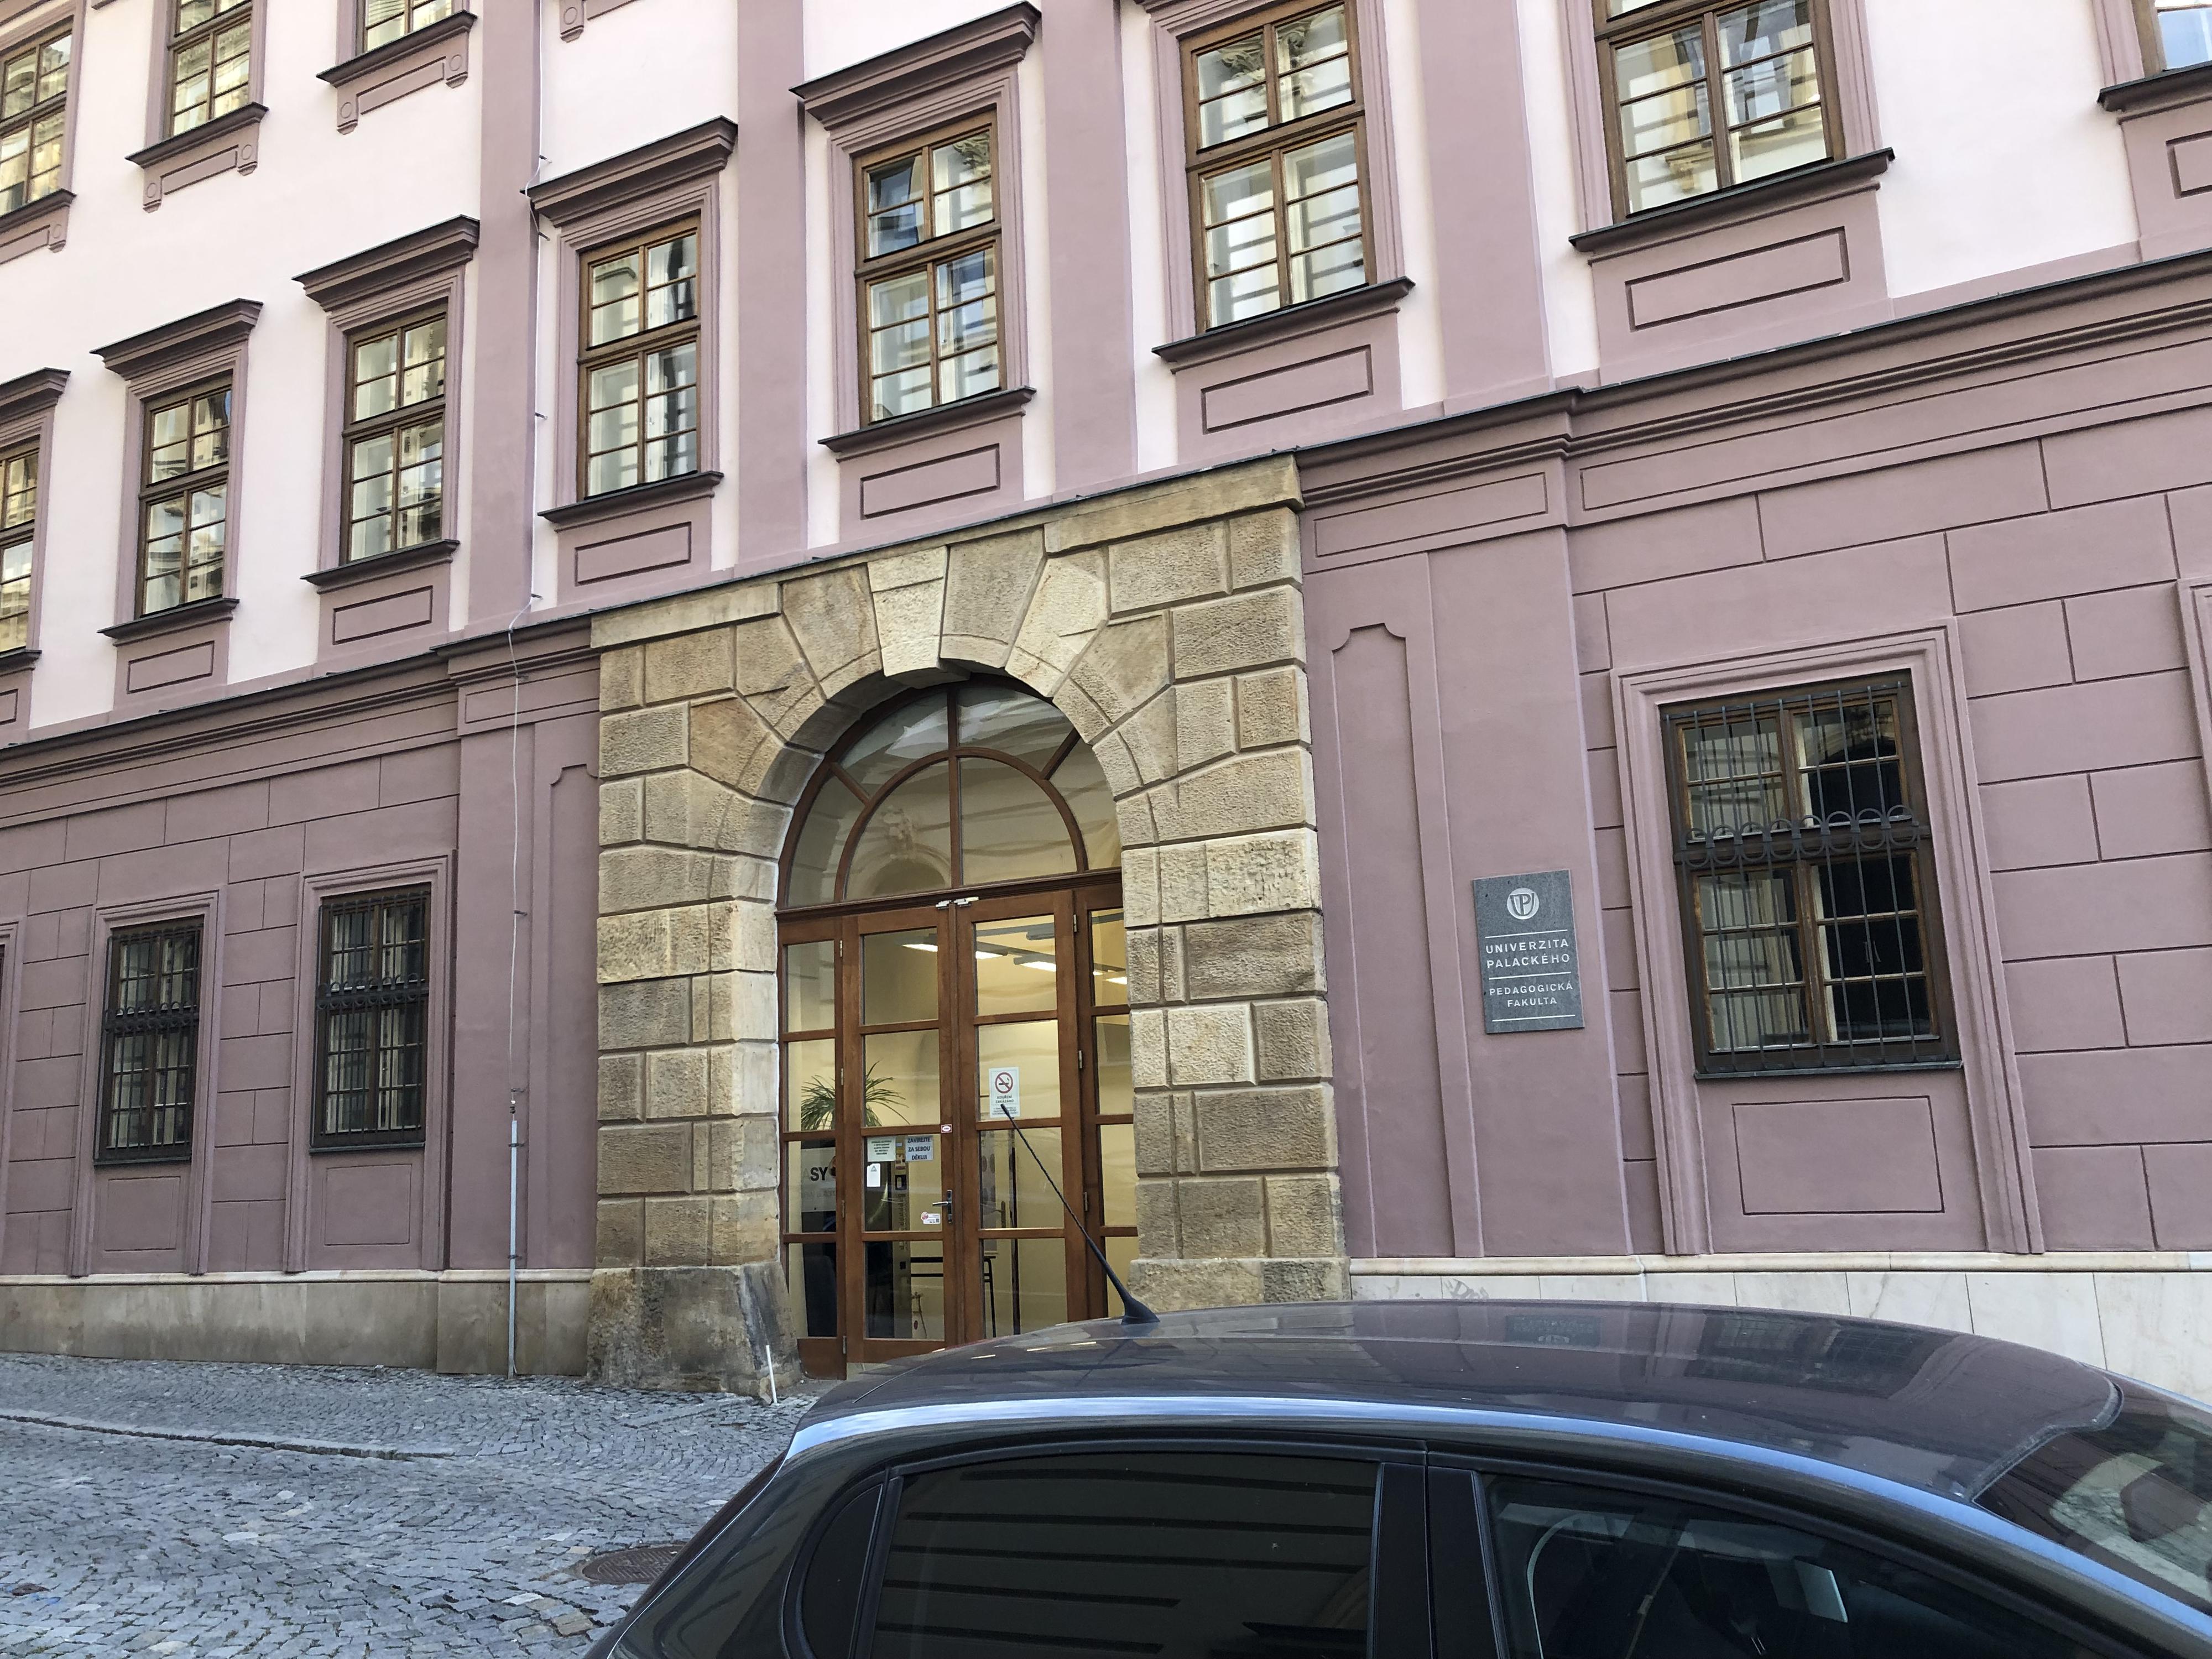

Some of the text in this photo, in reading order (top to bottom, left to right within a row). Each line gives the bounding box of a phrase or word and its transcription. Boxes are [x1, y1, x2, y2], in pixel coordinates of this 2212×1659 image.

[1485, 938, 1569, 953] UNIVERZITA
[1487, 953, 1570, 969] PALACKÉHO
[1490, 980, 1573, 995] PEDAGOGICKÁ
[1507, 997, 1557, 1007] FAKULTA
